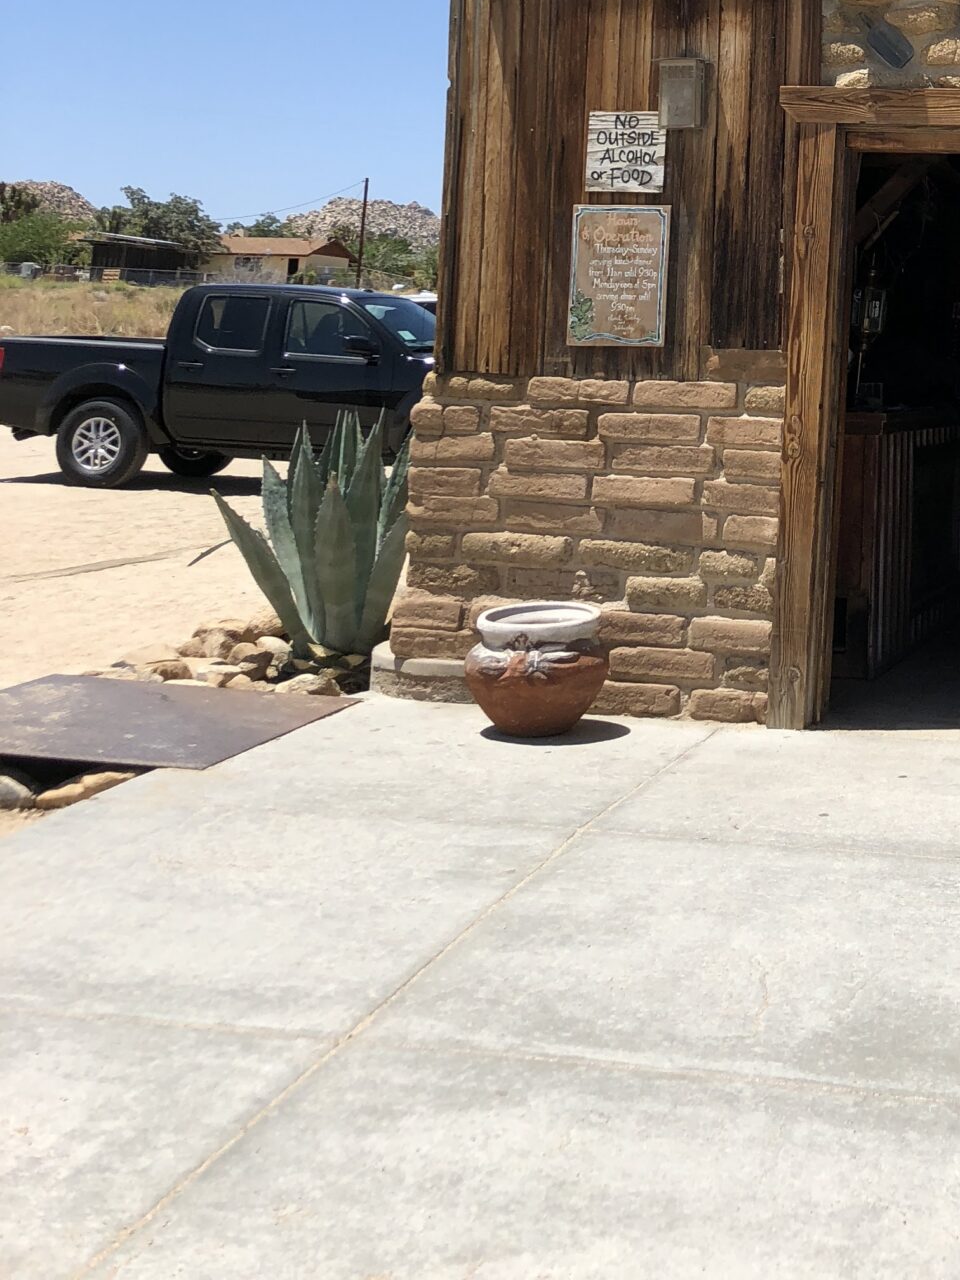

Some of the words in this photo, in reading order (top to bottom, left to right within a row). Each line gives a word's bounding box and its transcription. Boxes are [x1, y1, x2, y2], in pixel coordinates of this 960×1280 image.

[614, 114, 640, 130] NO
[596, 131, 660, 147] OUTSIDE
[599, 148, 659, 166] ALCOHOL
[607, 167, 653, 187] FOOD
